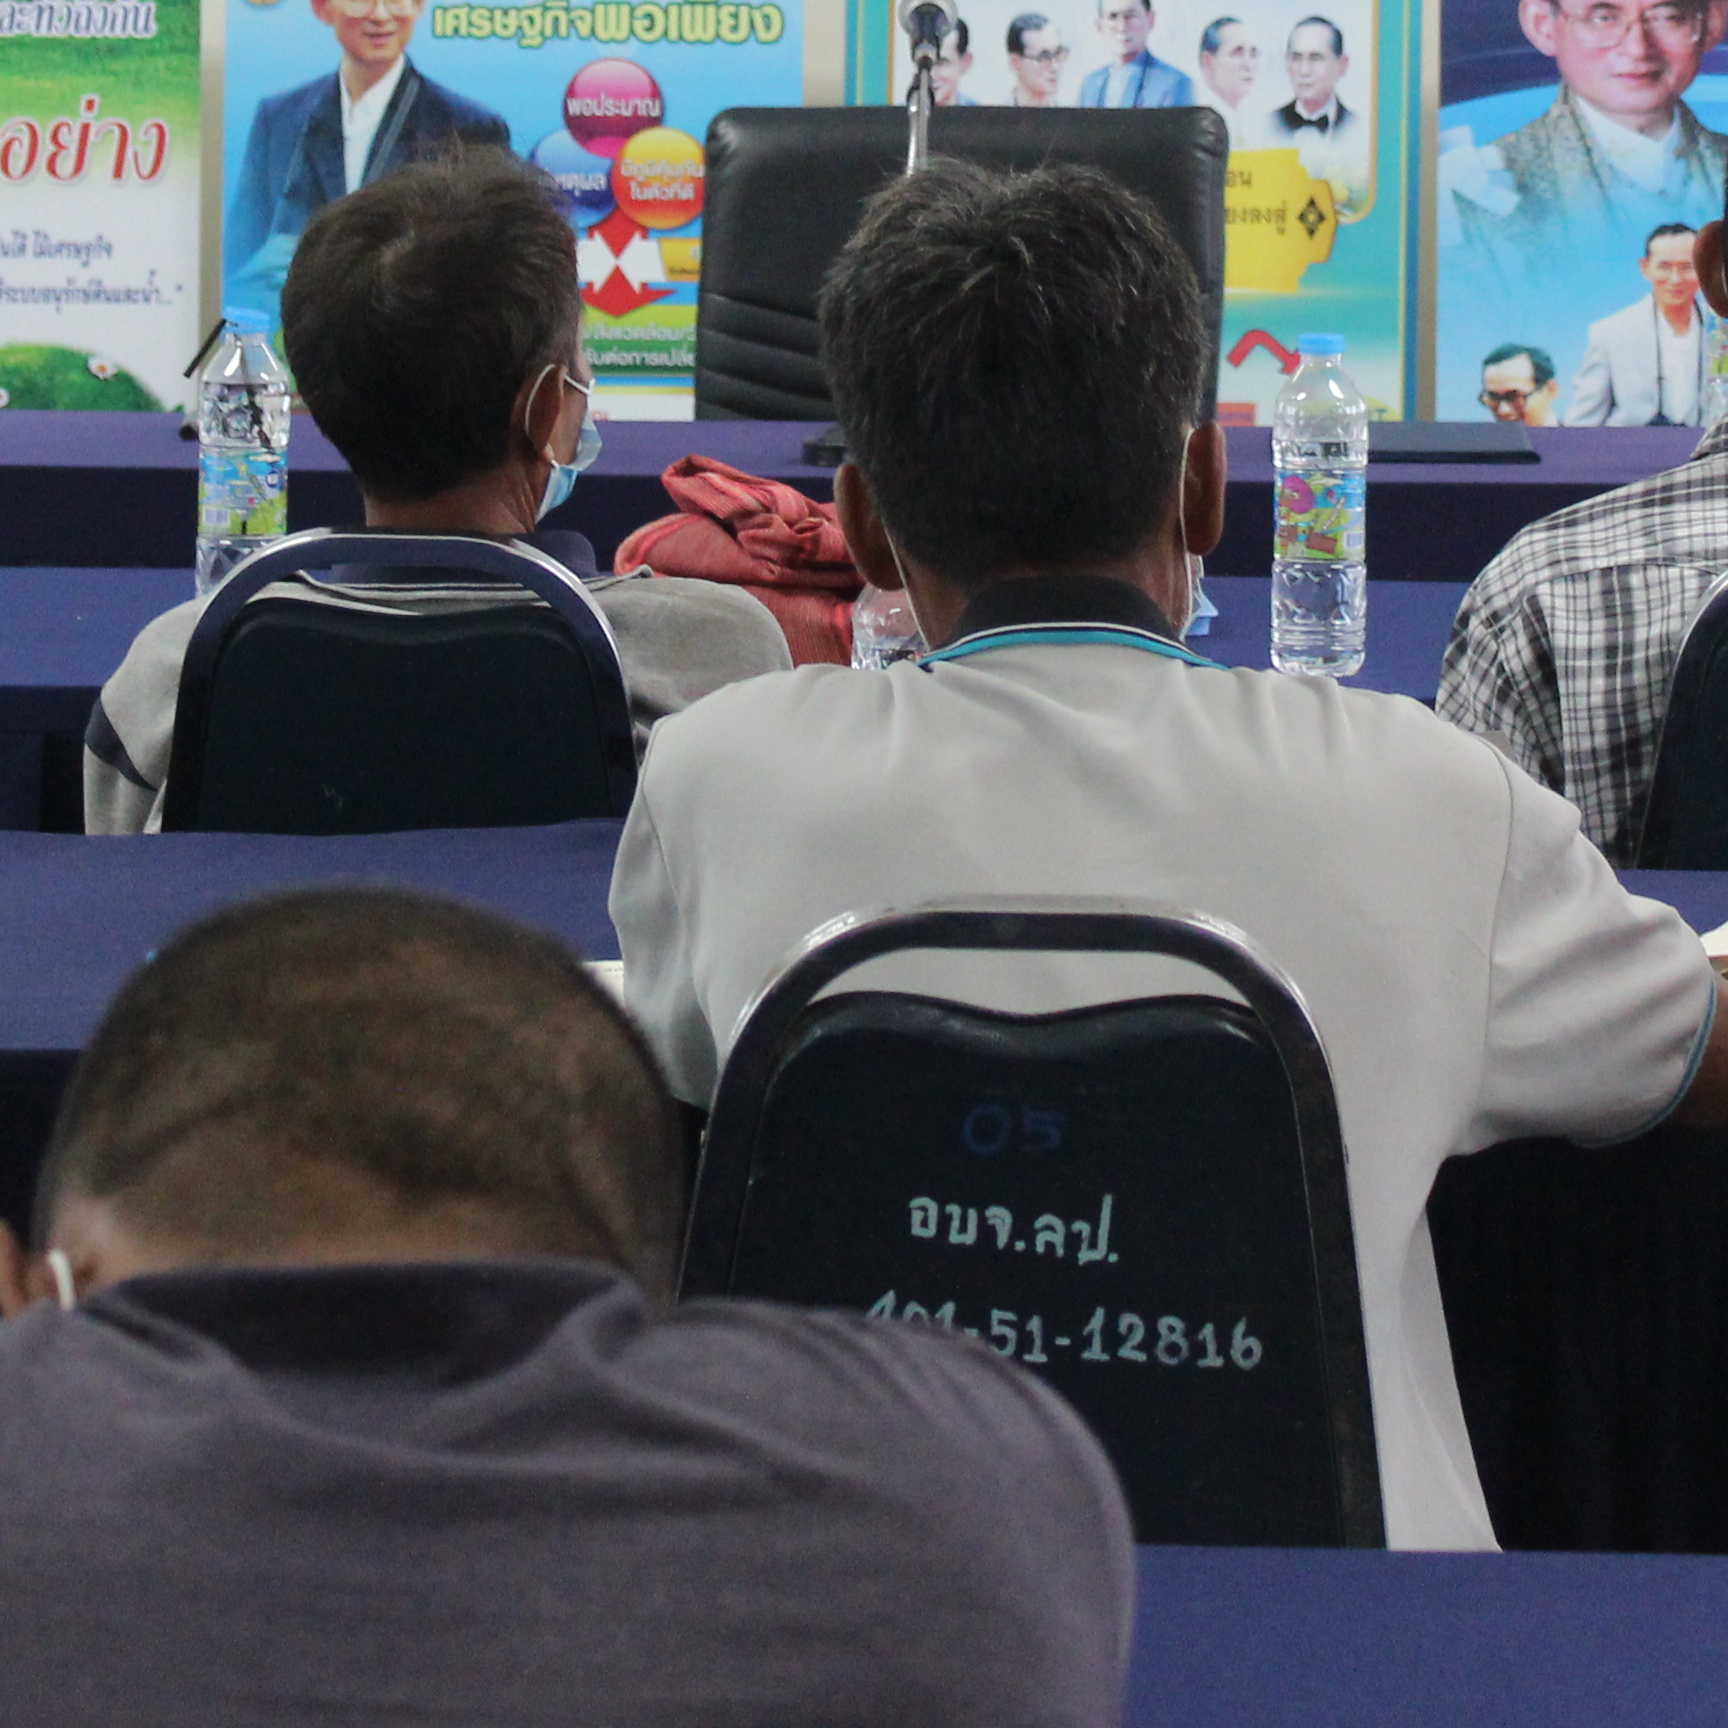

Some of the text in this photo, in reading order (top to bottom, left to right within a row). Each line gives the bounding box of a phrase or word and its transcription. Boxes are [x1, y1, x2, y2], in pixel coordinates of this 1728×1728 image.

[567, 93, 661, 117] พอประมาณ
[909, 1194, 1120, 1265] อบจ.ลป.
